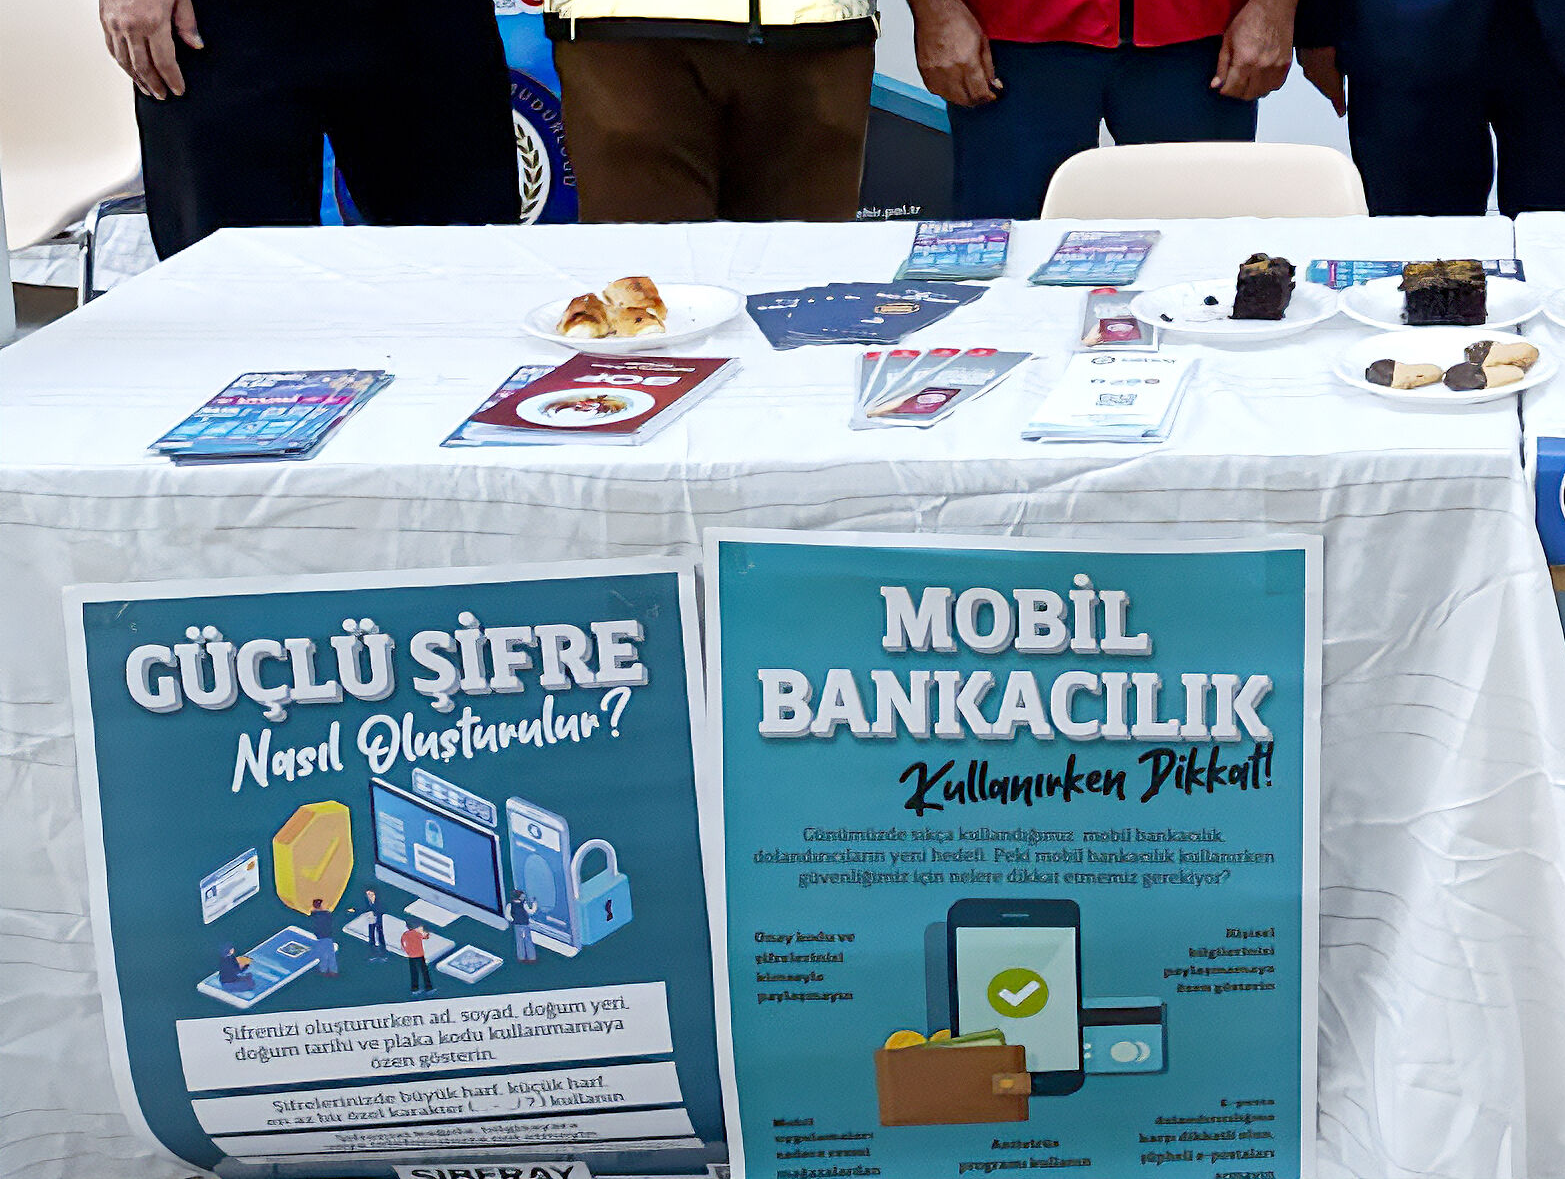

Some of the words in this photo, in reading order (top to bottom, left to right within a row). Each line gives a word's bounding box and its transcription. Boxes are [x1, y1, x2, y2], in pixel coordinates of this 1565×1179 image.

[881, 574, 1152, 655] MOBİL
[125, 625, 396, 722] GÜÇLÜ
[411, 612, 648, 712] ŞİFRE
[232, 722, 343, 793] Nasıl
[358, 687, 632, 774] Oluşturulur?
[758, 668, 1276, 740] BANKACILIK
[900, 755, 1126, 816] Kullanırken
[1139, 743, 1274, 804] Dikkat!
[1083, 827, 1131, 842] mobil
[235, 1040, 299, 1064] doğum
[358, 1037, 379, 1052] ve
[385, 1031, 435, 1053] plaka
[438, 1025, 484, 1046] kodu
[523, 1000, 586, 1022] doğum
